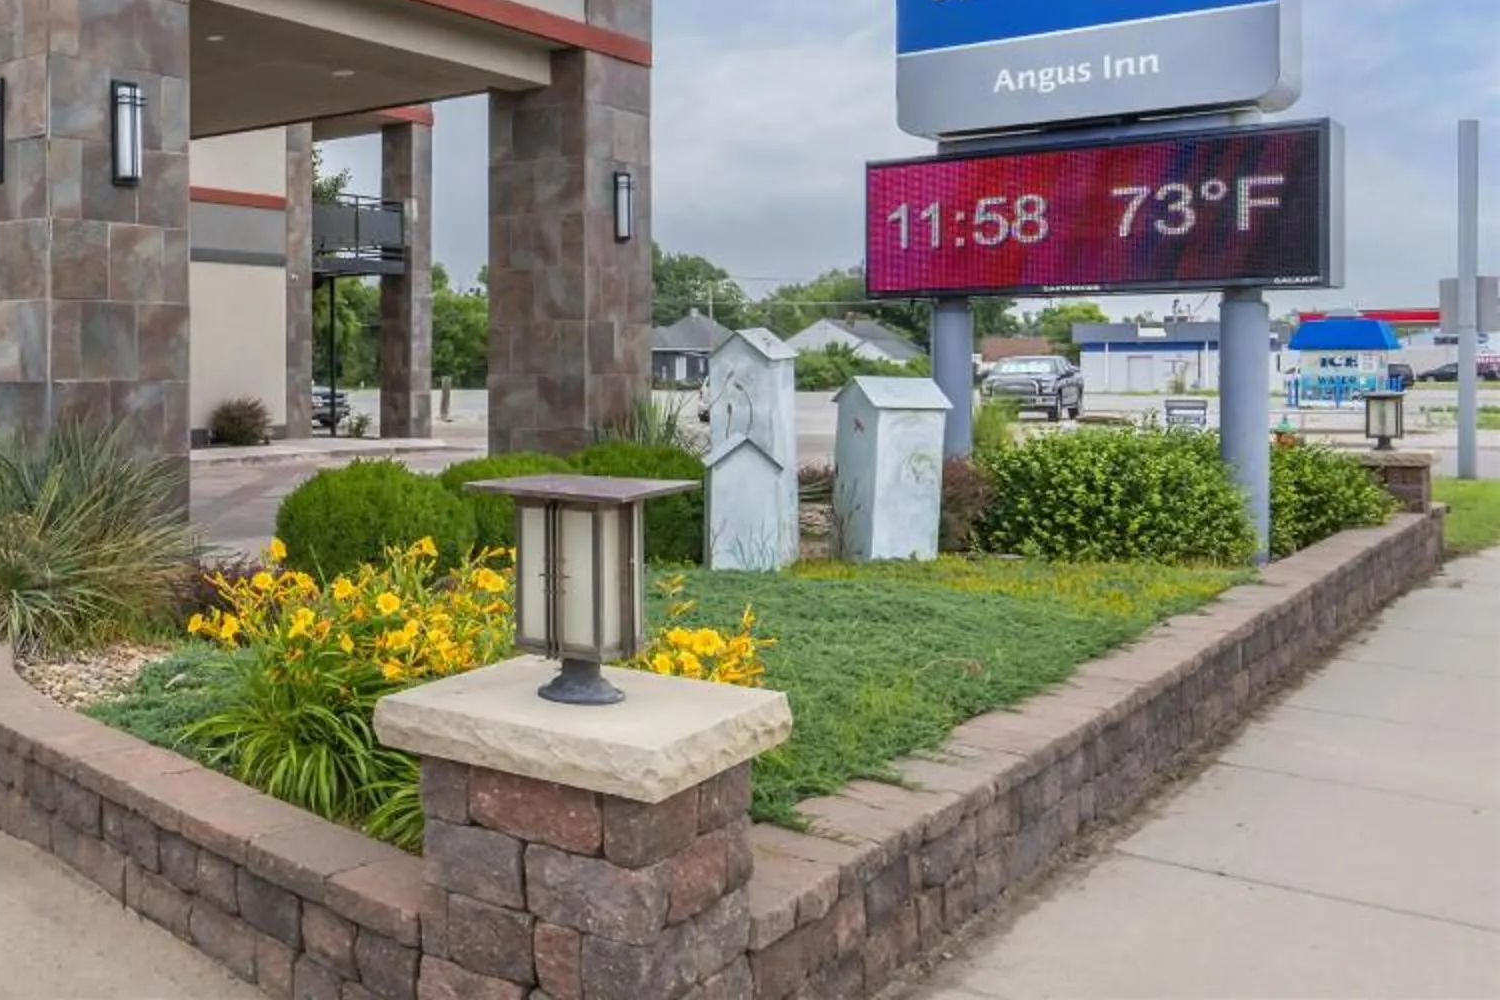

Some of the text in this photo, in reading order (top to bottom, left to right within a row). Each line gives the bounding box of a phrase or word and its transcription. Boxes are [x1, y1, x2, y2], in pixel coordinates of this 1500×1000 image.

[993, 53, 1160, 95] Angus Inn
[887, 173, 1285, 249] 11:58 73°F
[1320, 356, 1358, 368] ICE
[1318, 375, 1357, 385] WATER
